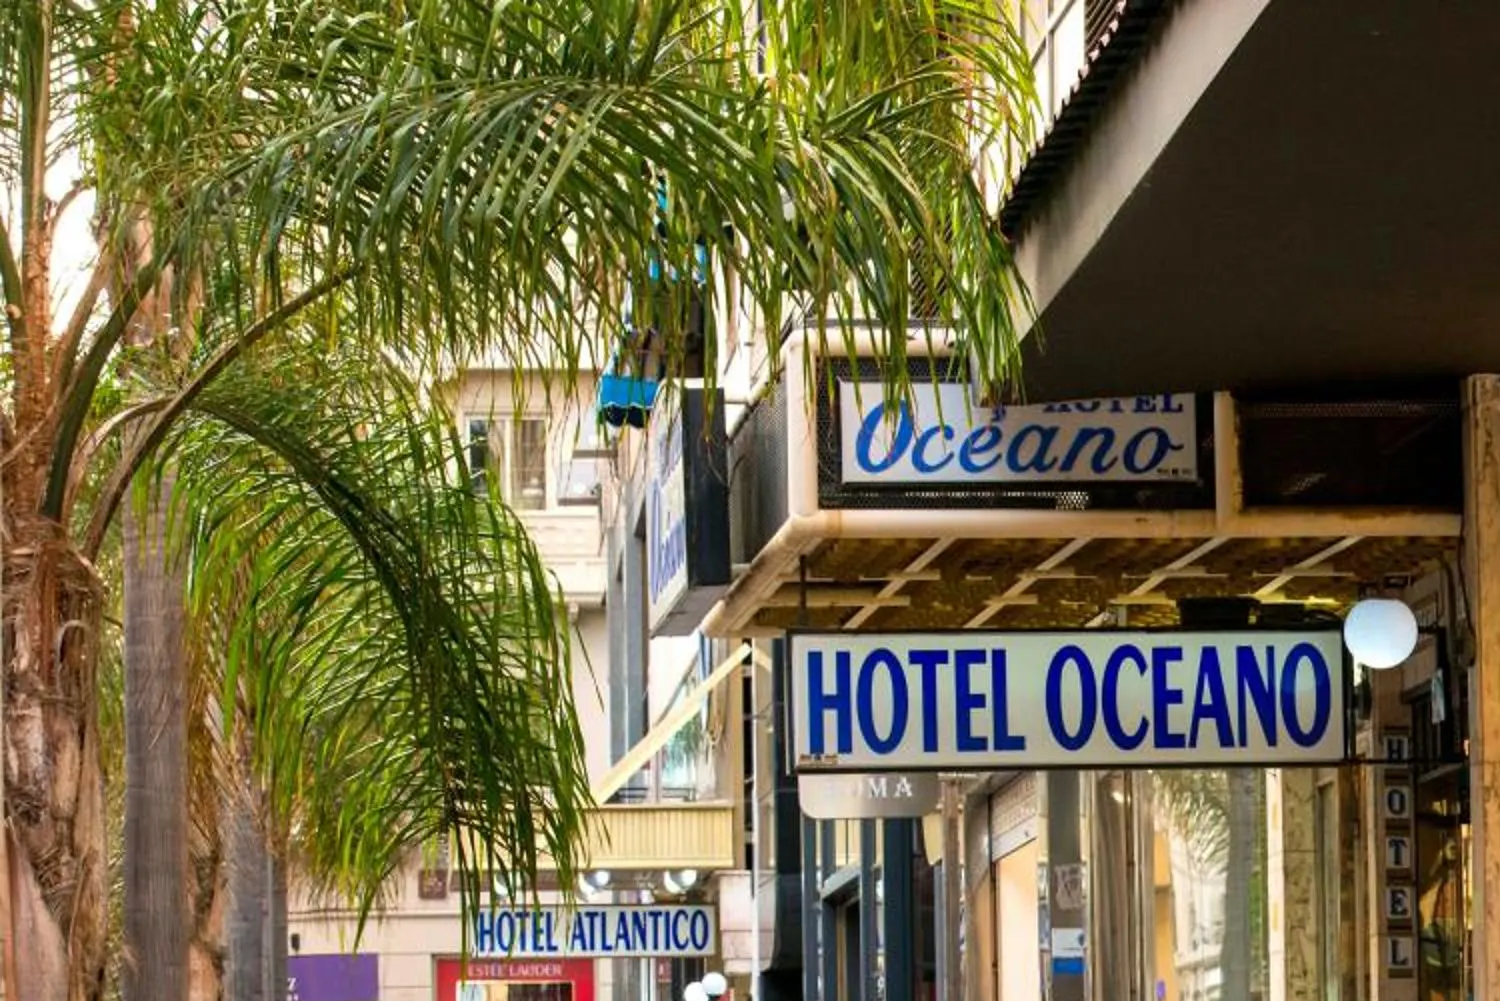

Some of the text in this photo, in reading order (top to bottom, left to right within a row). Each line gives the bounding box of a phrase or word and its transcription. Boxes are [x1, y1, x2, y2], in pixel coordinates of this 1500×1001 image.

[806, 642, 1332, 756] HOTEL OCEANO
[477, 908, 709, 953] HOTEL ATLANTICO
